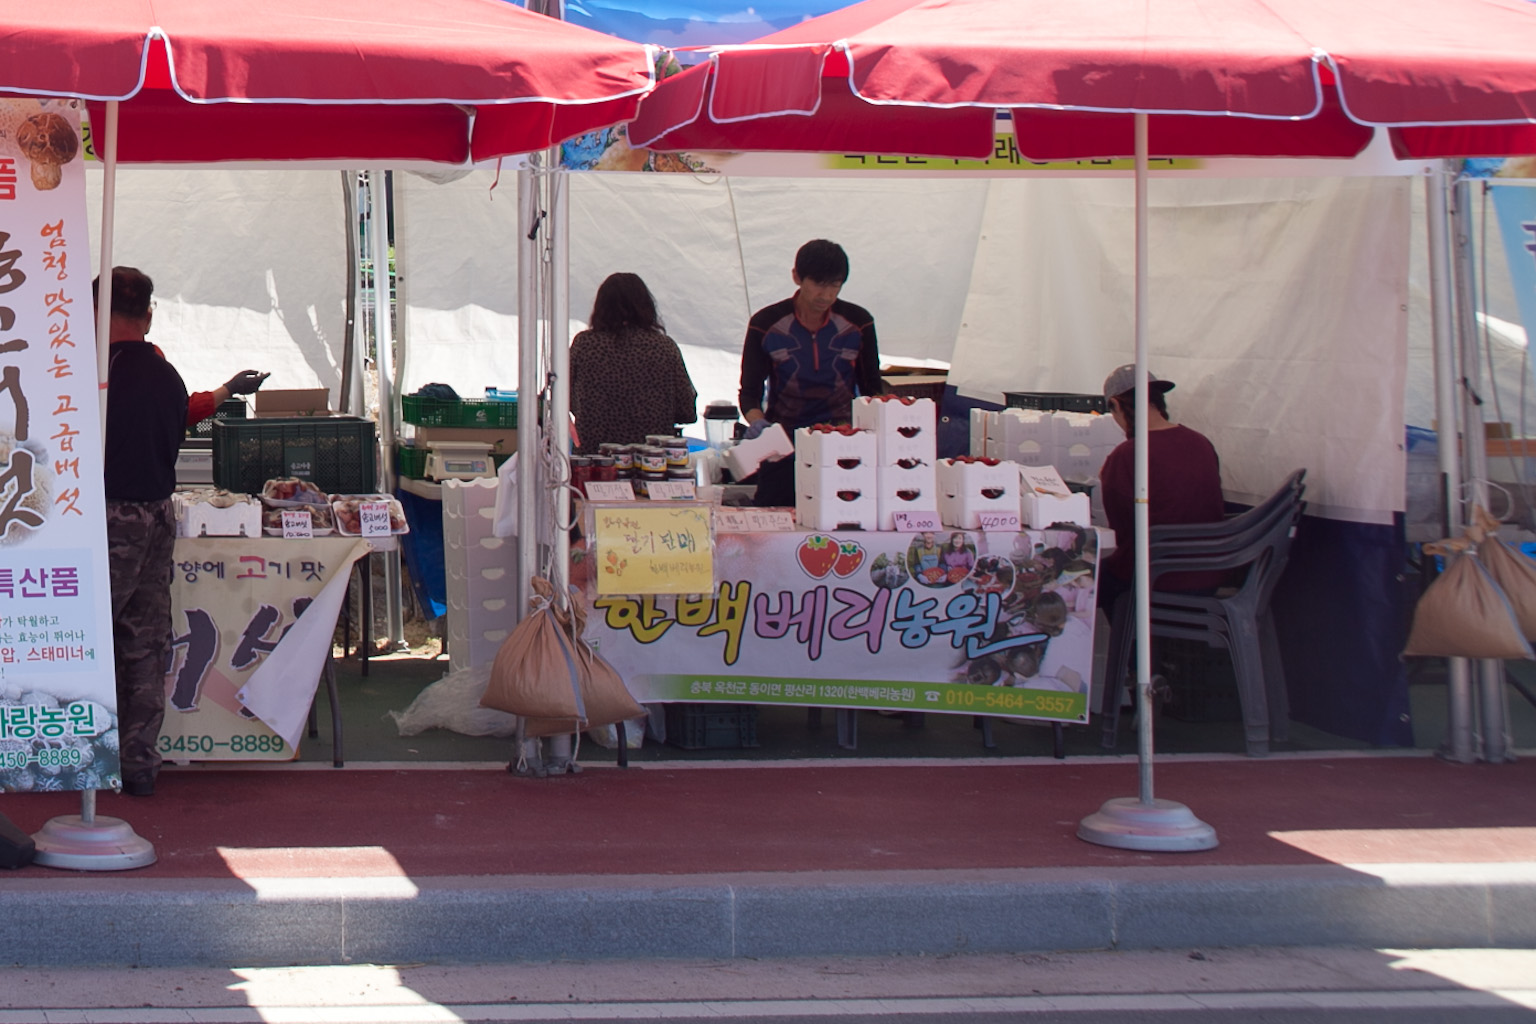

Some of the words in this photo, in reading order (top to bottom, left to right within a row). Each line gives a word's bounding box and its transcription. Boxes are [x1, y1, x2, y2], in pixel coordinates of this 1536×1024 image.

[40, 219, 68, 280] 엄청
[45, 288, 76, 379] 맛있는
[170, 561, 224, 583] 향에
[301, 561, 325, 582] 맛
[17, 616, 59, 628] 탁월하고
[594, 581, 1049, 666] 한백베리농원
[18, 631, 49, 643] 효능이
[54, 630, 85, 642] 뛰어나
[27, 646, 95, 662] 스태미너에
[690, 681, 712, 694] 충북
[714, 682, 747, 695] 옥천군
[749, 682, 781, 696] 동이면
[784, 684, 815, 697] 평산리
[946, 689, 1075, 714] 010-5464-3557
[156, 734, 284, 753] 3450-8889
